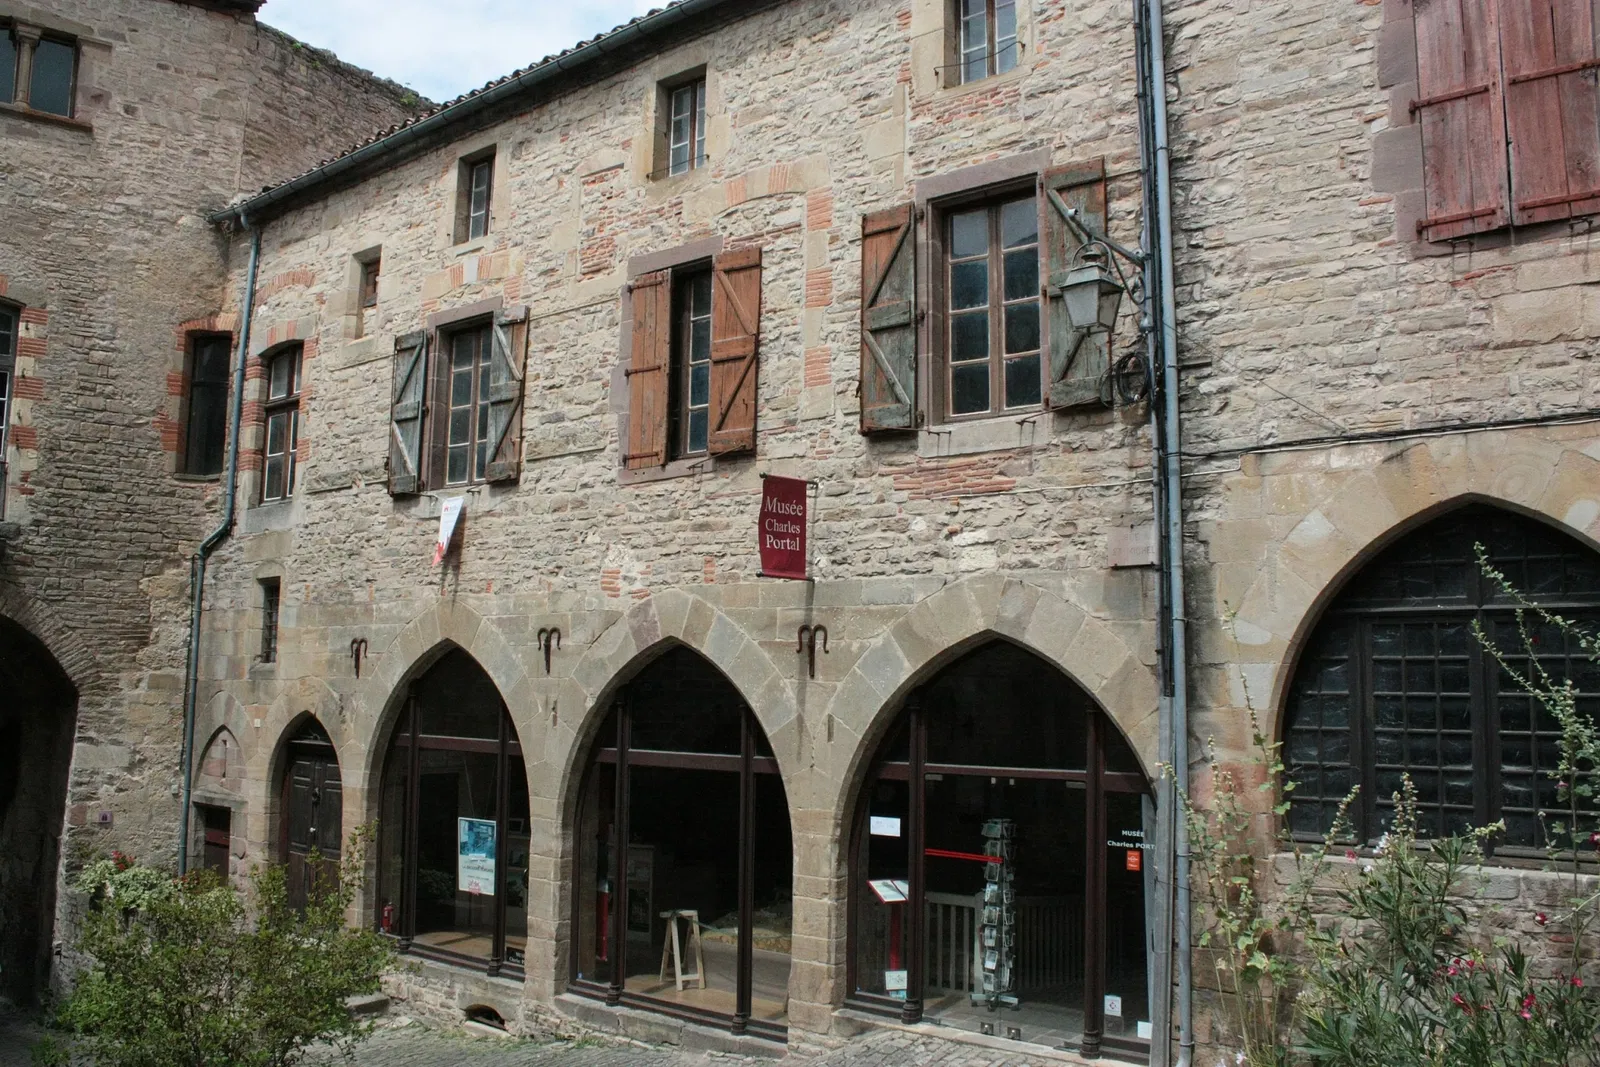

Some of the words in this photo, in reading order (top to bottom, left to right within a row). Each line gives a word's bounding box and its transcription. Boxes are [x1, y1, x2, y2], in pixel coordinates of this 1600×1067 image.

[764, 496, 803, 516] Musée
[765, 518, 800, 534] Charles
[766, 534, 800, 551] Portal
[1122, 830, 1145, 838] MUSÉE
[1107, 840, 1134, 848] Charles
